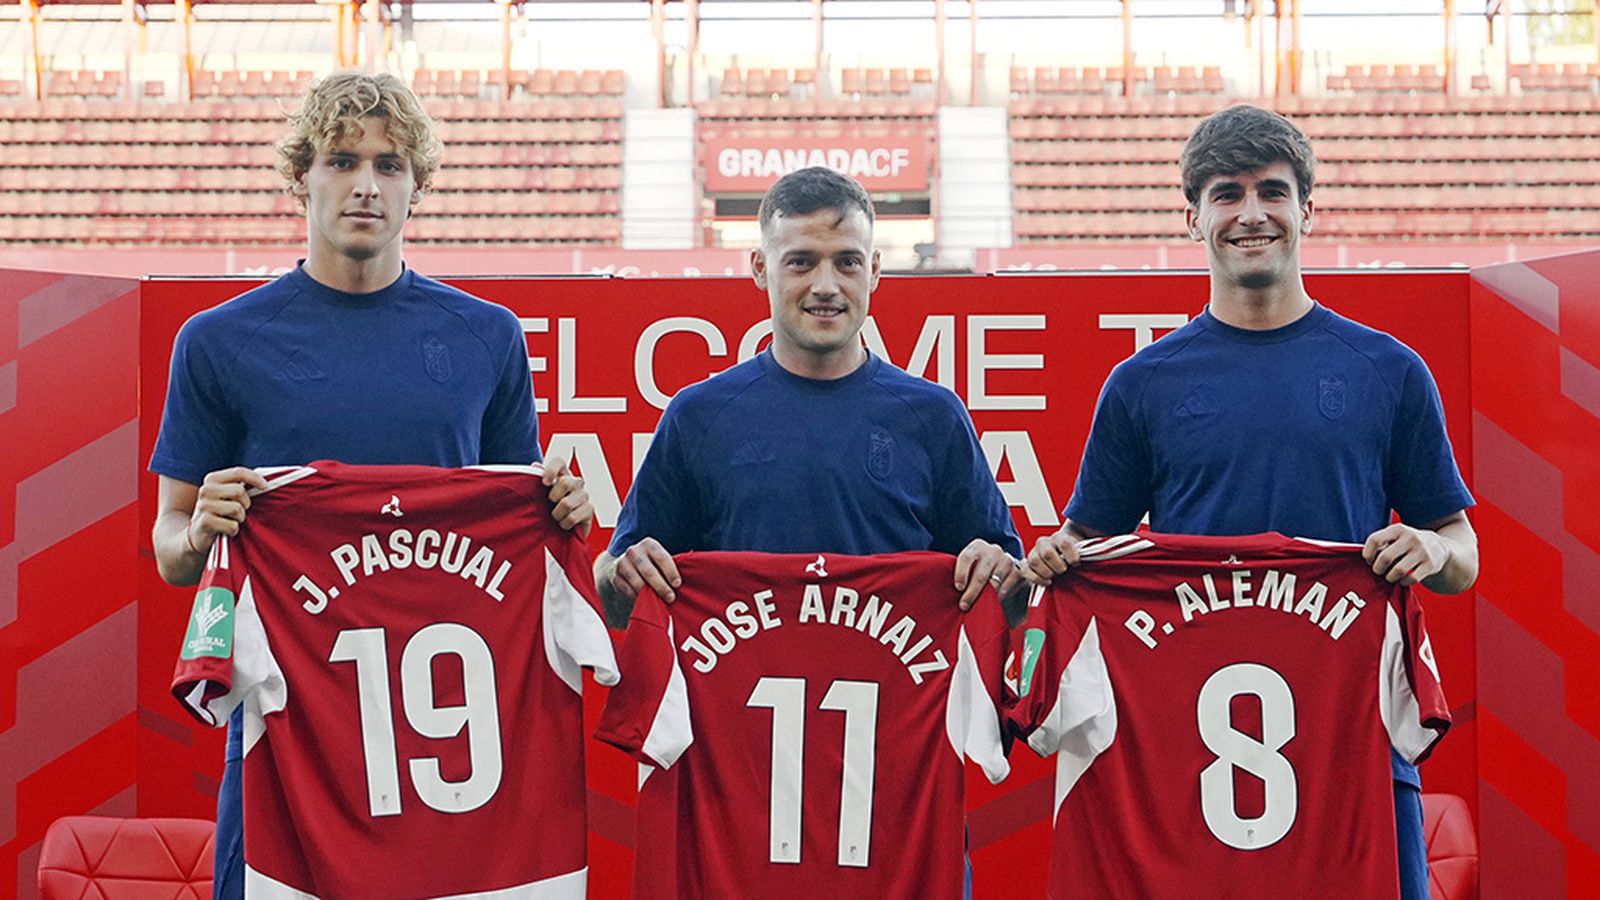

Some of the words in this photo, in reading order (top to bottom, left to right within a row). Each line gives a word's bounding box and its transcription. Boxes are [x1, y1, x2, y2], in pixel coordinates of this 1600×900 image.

[680, 588, 782, 674] JOSE
[799, 583, 950, 686] ARNAIZ
[1124, 608, 1175, 650] P.
[1174, 569, 1367, 641] ALEMAÑ
[328, 622, 504, 817] 19
[746, 676, 880, 868] 11
[1196, 662, 1298, 850] 8
